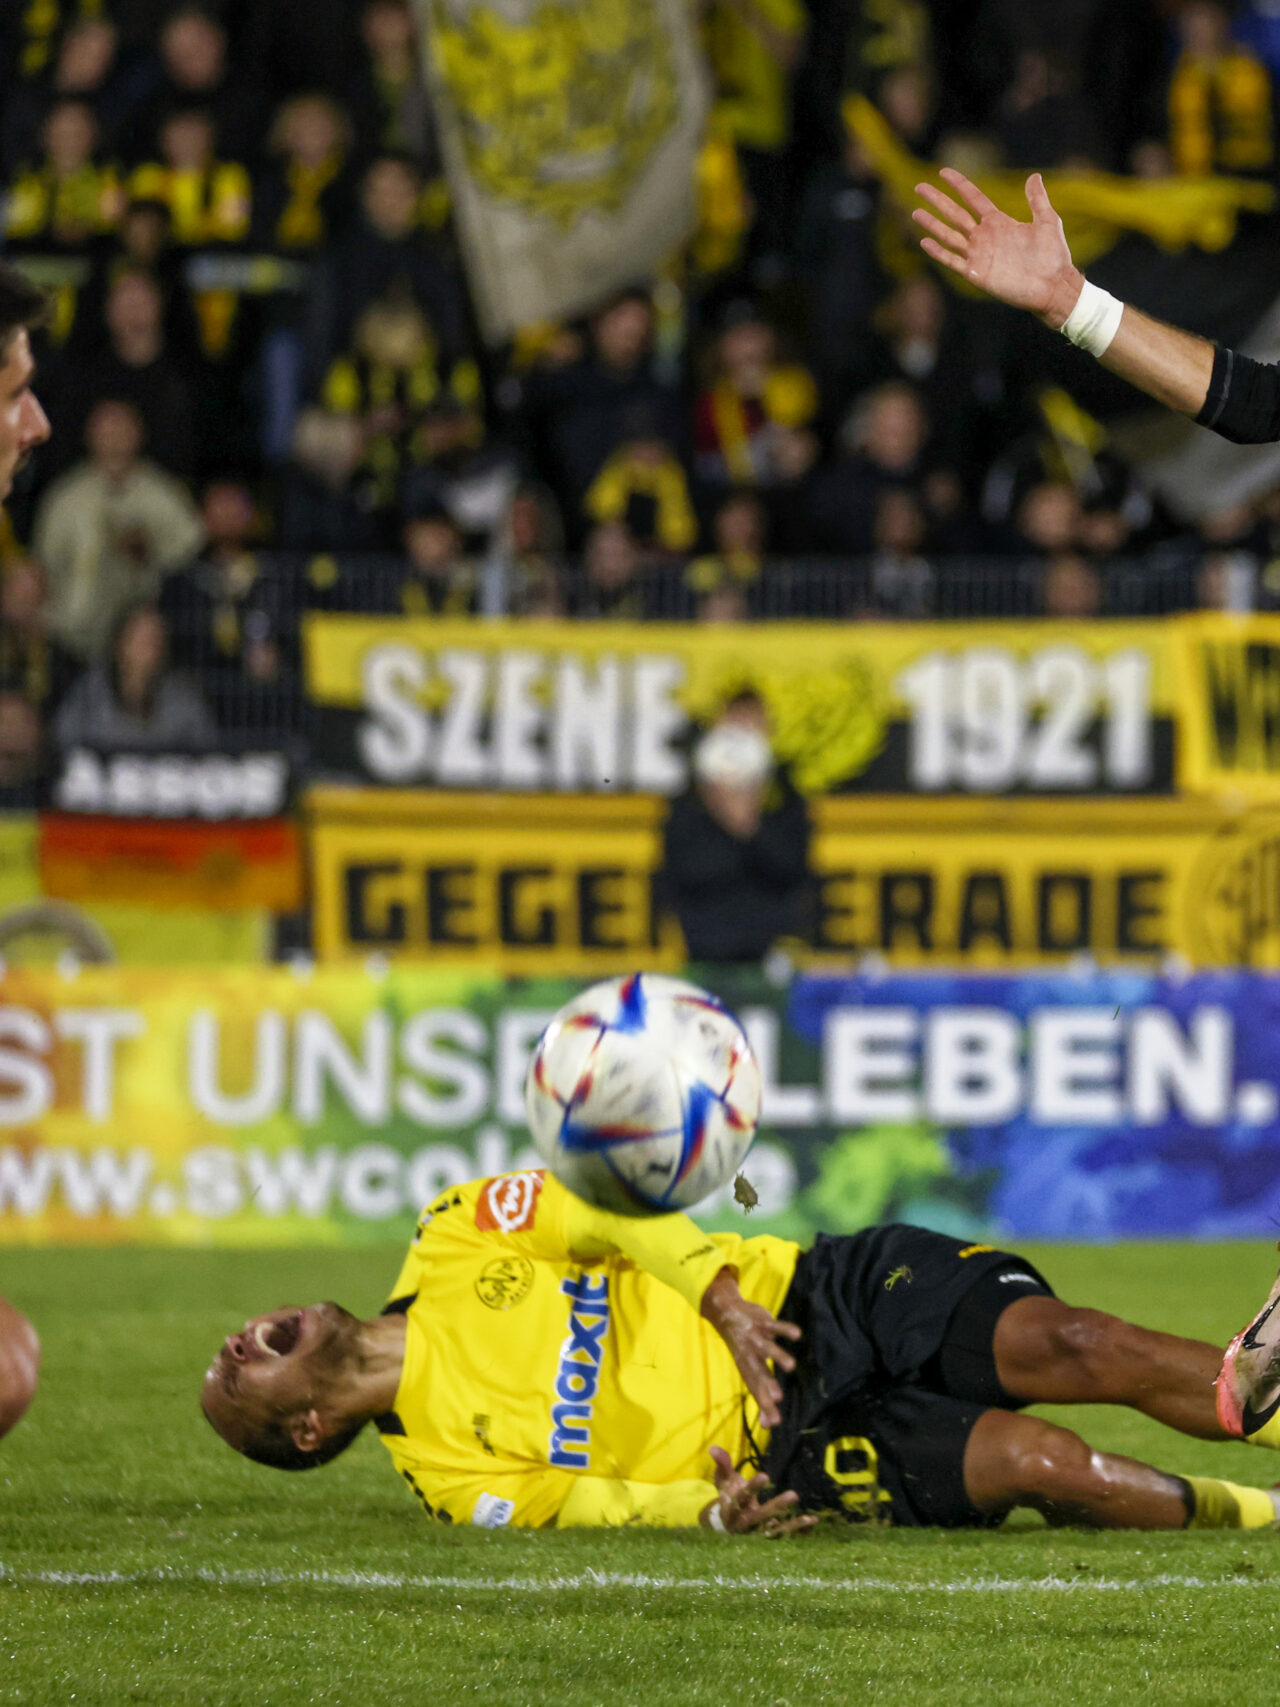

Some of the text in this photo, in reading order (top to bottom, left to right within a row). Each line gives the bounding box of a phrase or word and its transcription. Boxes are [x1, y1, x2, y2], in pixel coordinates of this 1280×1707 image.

[361, 643, 688, 793] SZENE
[897, 643, 1152, 790] 1921
[188, 1007, 552, 1129] UNSE
[738, 1006, 1279, 1127] LEBEN.
[549, 1271, 611, 1469] maxit
